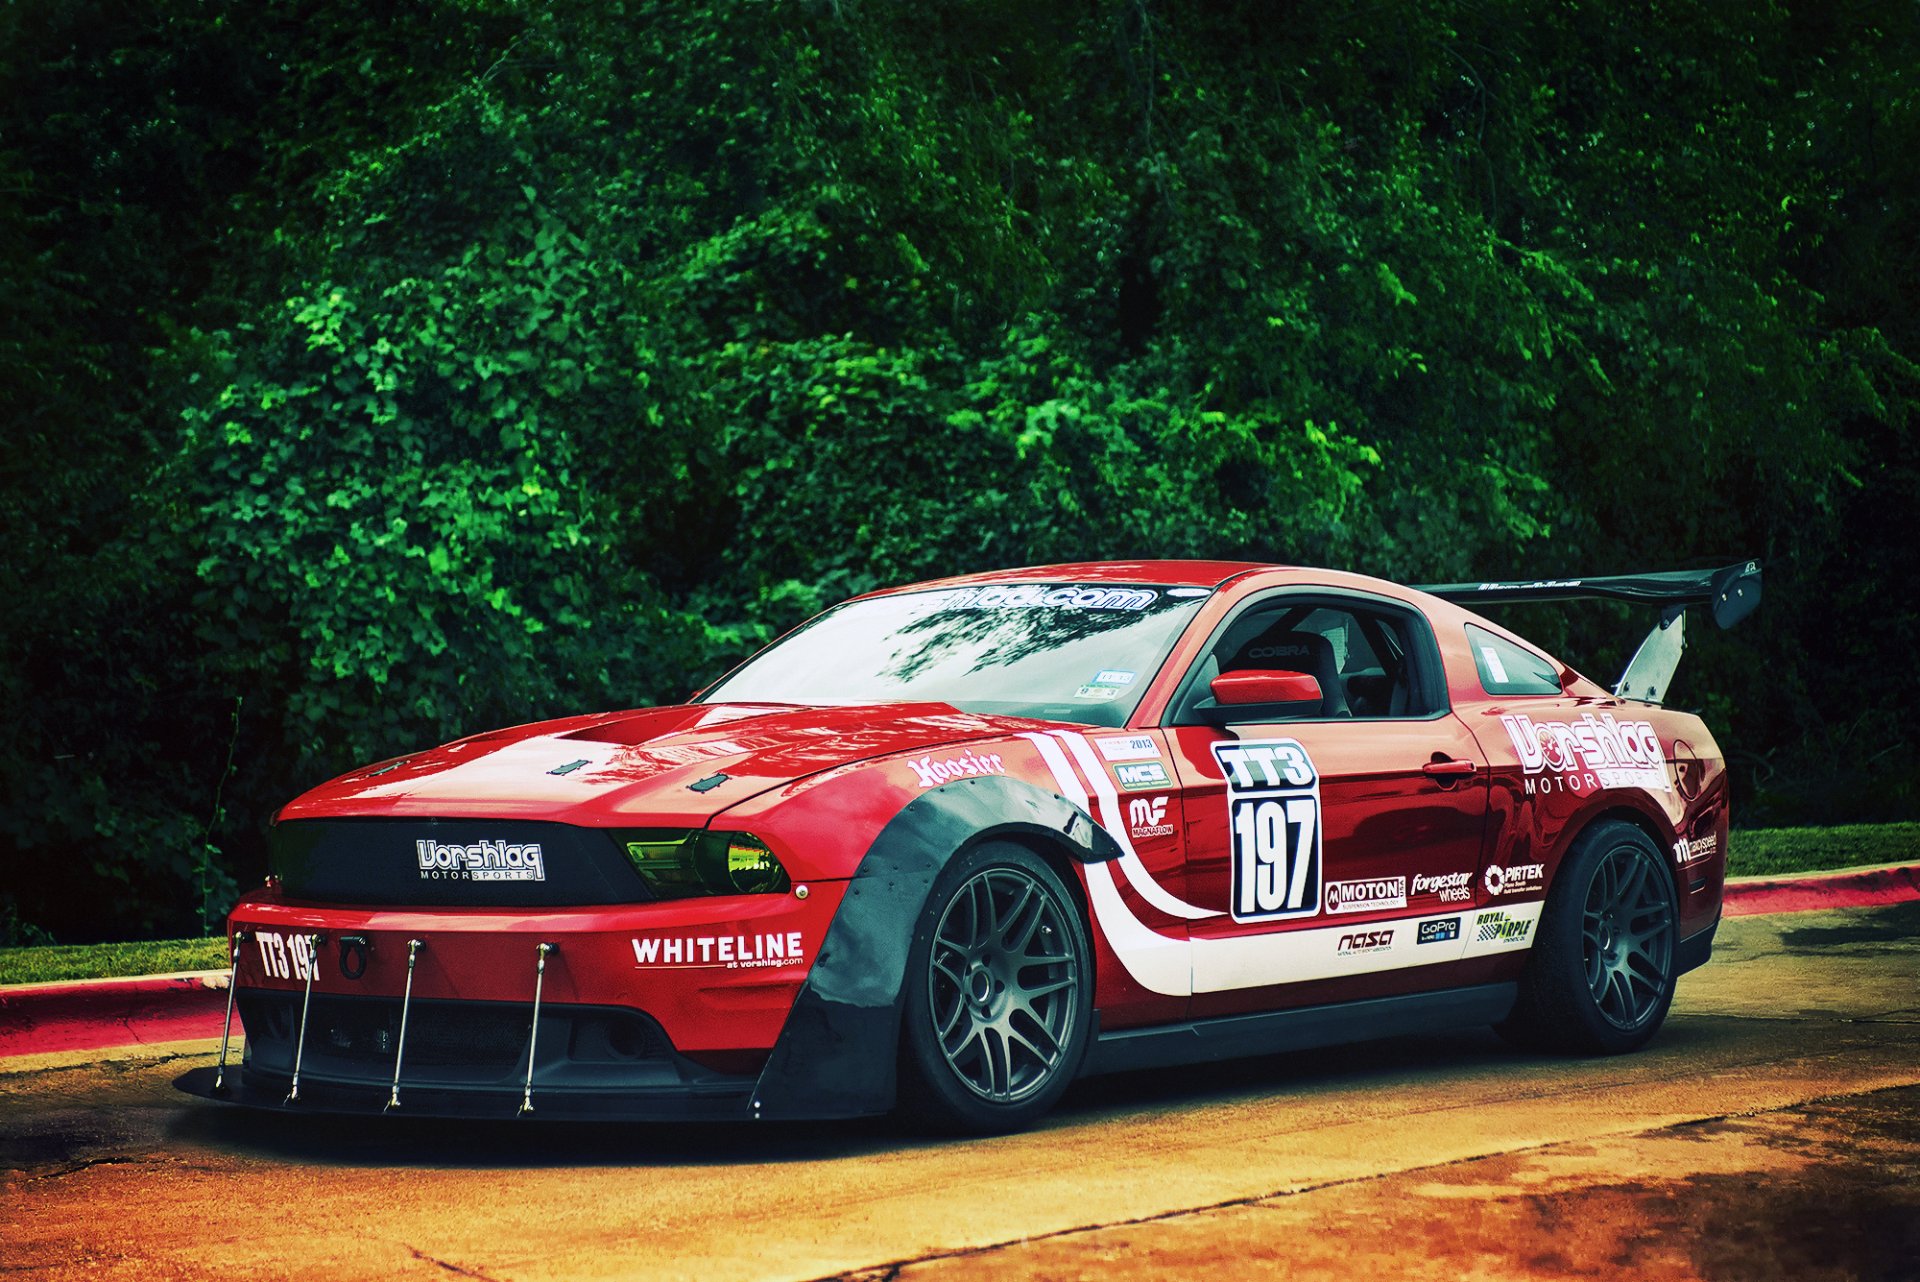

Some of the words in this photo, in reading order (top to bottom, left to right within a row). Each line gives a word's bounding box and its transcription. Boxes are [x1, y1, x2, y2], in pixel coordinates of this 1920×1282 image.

[1248, 645, 1310, 659] COBRA
[1129, 739, 1153, 749] 2013
[907, 749, 1005, 787] Hoosier
[1118, 764, 1166, 784] MCS
[1217, 746, 1314, 788] TT3
[1524, 772, 1663, 795] MOTORSPORTS
[1132, 825, 1173, 838] MAGNAFLOW
[1235, 799, 1316, 913] 197
[420, 870, 535, 881] MOTORSPORTS
[1504, 864, 1545, 881] PIRTEK
[1341, 881, 1398, 902] MOTON
[1411, 872, 1473, 896] forgestar
[1439, 884, 1471, 902] wheels
[1421, 921, 1456, 934] GoPro
[1477, 912, 1504, 925] ROYAL
[1494, 917, 1532, 939] PURPLE
[631, 932, 804, 963] WHITELINE
[1337, 930, 1395, 951] nasa
[255, 931, 290, 980] TT3
[740, 958, 803, 967] vorshlag.com
